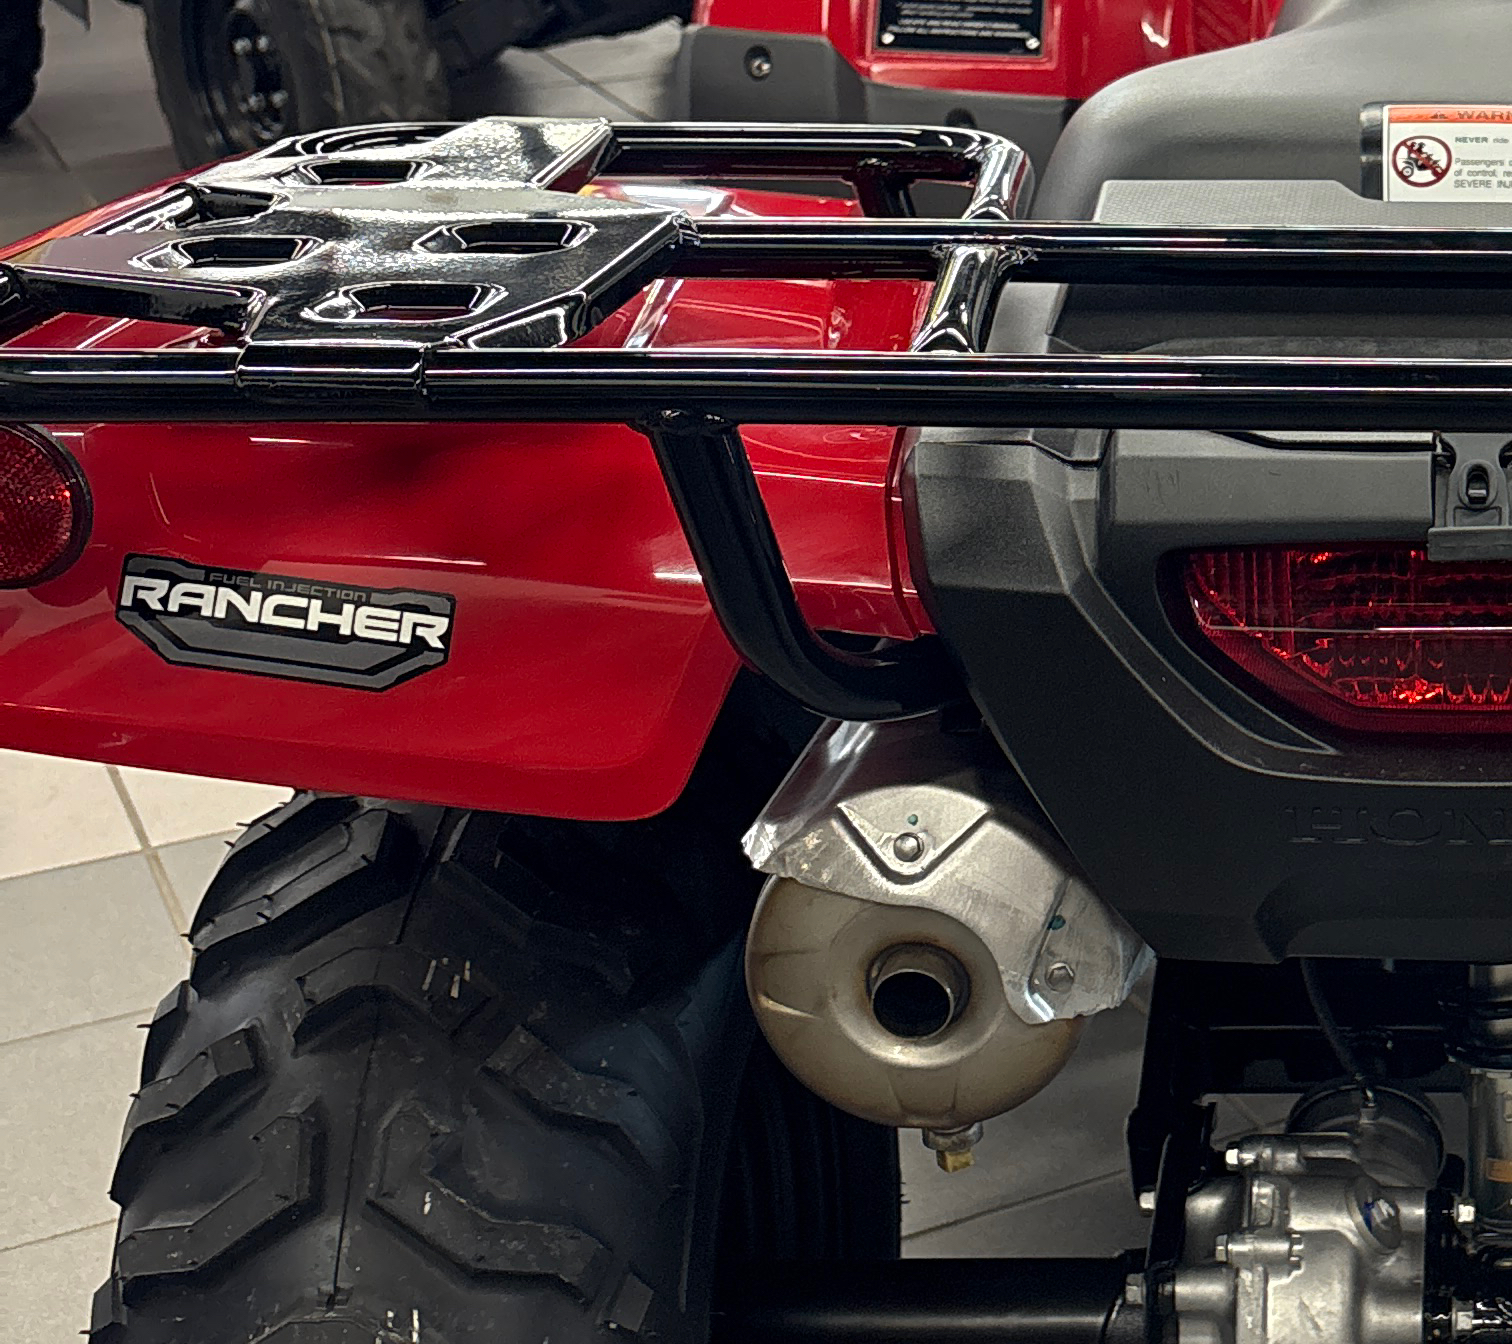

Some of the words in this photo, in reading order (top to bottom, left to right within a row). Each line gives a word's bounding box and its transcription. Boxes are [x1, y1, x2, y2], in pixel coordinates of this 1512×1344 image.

[1454, 136, 1488, 144] NEVER
[1455, 158, 1504, 167] Passengers
[1453, 168, 1462, 176] of
[1454, 179, 1492, 189] SEVERE
[210, 572, 261, 588] FUEL
[267, 579, 367, 602] INJECTION
[120, 574, 450, 649] RANCHER
